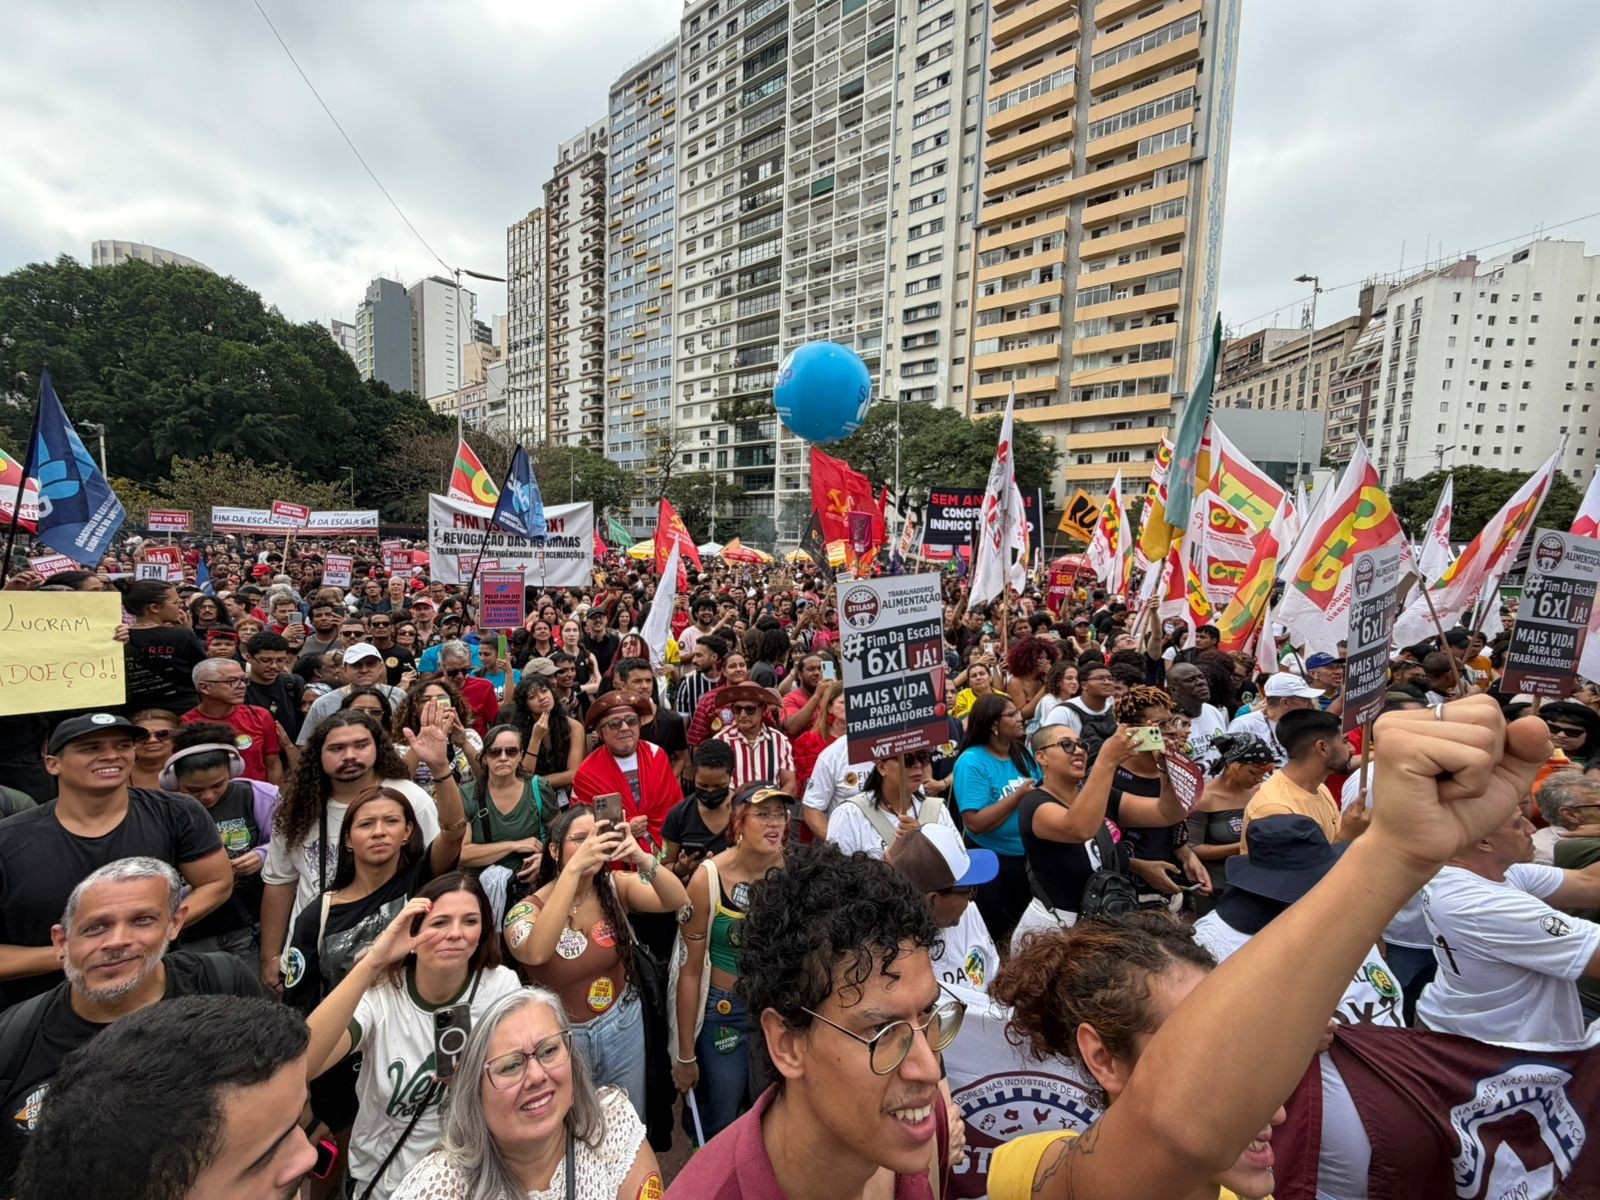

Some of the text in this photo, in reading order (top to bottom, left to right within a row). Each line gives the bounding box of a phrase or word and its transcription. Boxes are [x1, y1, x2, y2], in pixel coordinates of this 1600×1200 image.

[931, 494, 956, 506] SEM
[453, 513, 478, 529] FIM
[1069, 496, 1100, 533] RU
[443, 531, 505, 550] REVOGAÇÃO
[507, 535, 528, 548] DAS
[36, 556, 74, 572] REFORMA
[147, 551, 172, 563] NÃO
[142, 566, 162, 578] FIM
[888, 586, 935, 597] TRABALHADORES
[1562, 582, 1573, 593] Da
[1573, 584, 1595, 597] Escala
[847, 603, 876, 613] STILASP
[910, 605, 928, 613] PAULO
[1376, 601, 1385, 613] Da
[1538, 592, 1588, 624] 6x1 JÁ!
[889, 631, 905, 644] Da
[907, 623, 941, 640] Escala
[1362, 614, 1384, 645] 6x1
[1516, 628, 1575, 649] MAIS VIDA
[148, 646, 175, 655] RED
[1528, 644, 1562, 657] PARA OS
[867, 643, 938, 676] 6x1 JÁ!
[1349, 655, 1373, 679] MAIS
[1510, 653, 1573, 669] TRABALHADORES
[1358, 672, 1375, 686] PARA
[1519, 680, 1537, 692] VAT
[849, 681, 929, 710] MAIS VIDA
[869, 699, 913, 717] PARA OS
[847, 706, 934, 733] TRABALHADORES
[1356, 711, 1369, 725] VAT
[870, 743, 893, 757] VAT
[564, 947, 581, 957] 6X1
[943, 967, 968, 985] DA
[954, 1088, 985, 1106] ADORES
[986, 1081, 1004, 1094] NAS
[1005, 1077, 1059, 1092] INDÚSTRIAS
[1060, 1084, 1073, 1095] DE
